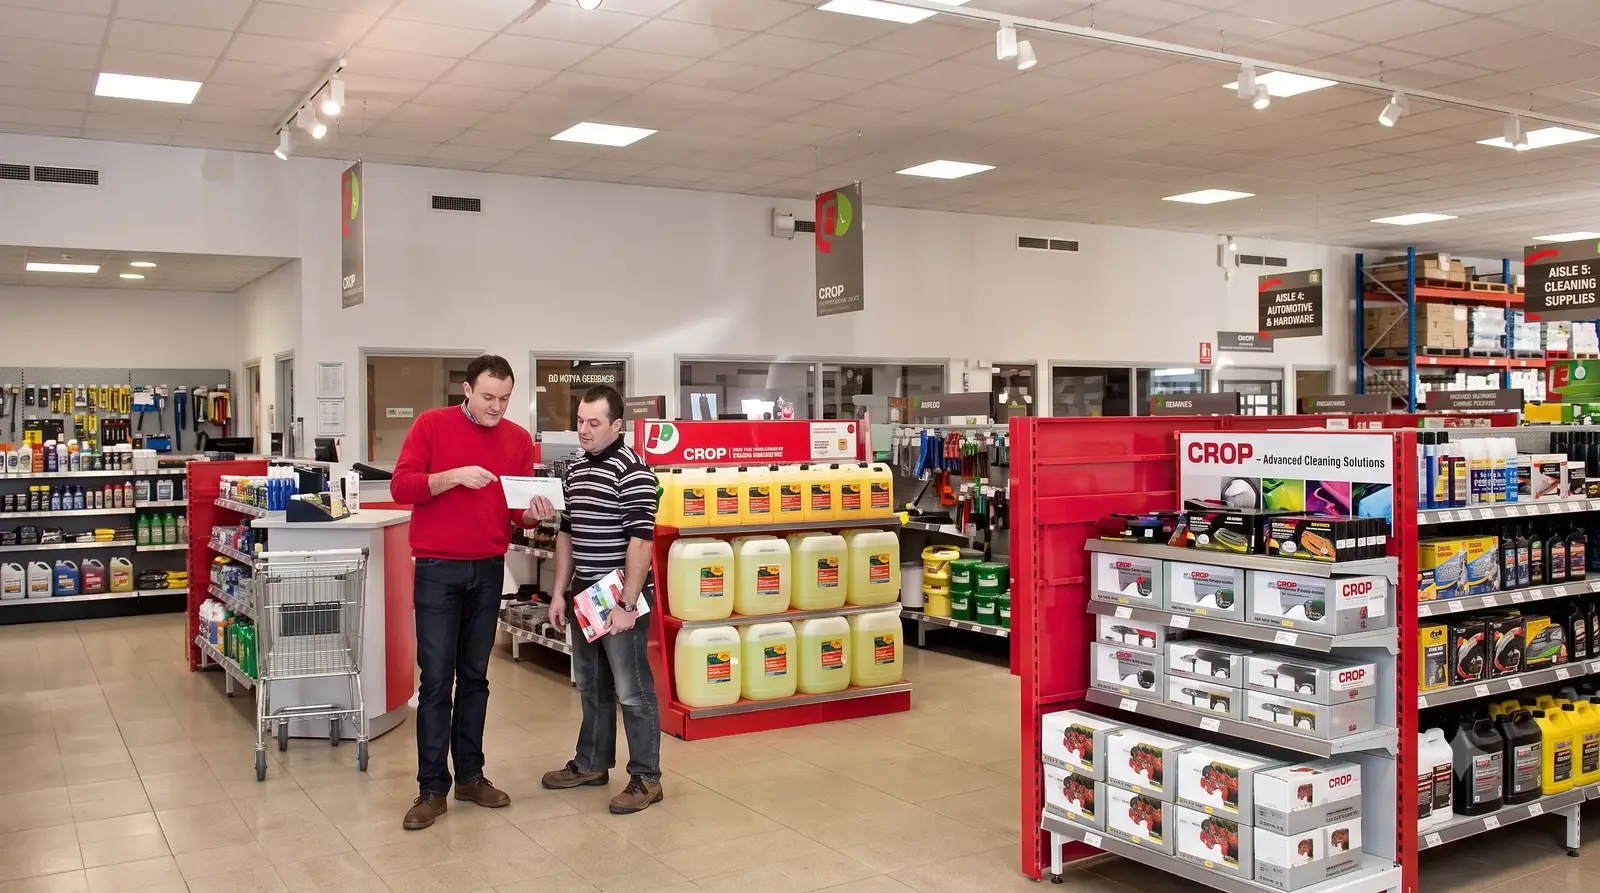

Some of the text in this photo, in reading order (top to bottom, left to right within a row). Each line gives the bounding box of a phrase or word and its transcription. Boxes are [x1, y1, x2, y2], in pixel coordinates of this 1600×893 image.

[1548, 264, 1591, 278] AISLE 5:
[818, 284, 845, 300] CROP
[1544, 278, 1597, 293] CLEANING
[1275, 291, 1305, 303] AISLE 4:
[1545, 292, 1596, 307] SUPPLIES
[1267, 302, 1313, 315] AUTOMOTIVE
[1266, 314, 1315, 327] & HARDWARE
[683, 447, 727, 461] CROP
[1187, 441, 1254, 465] CROP
[1263, 454, 1302, 466] Advanced
[1304, 455, 1341, 469] Cleaning
[1343, 456, 1385, 469] Solutions
[1191, 571, 1209, 579] CROP
[1276, 580, 1297, 588] CROP
[1342, 581, 1373, 597] CROP
[1338, 668, 1366, 684] CROP
[1328, 774, 1352, 789] CROP
